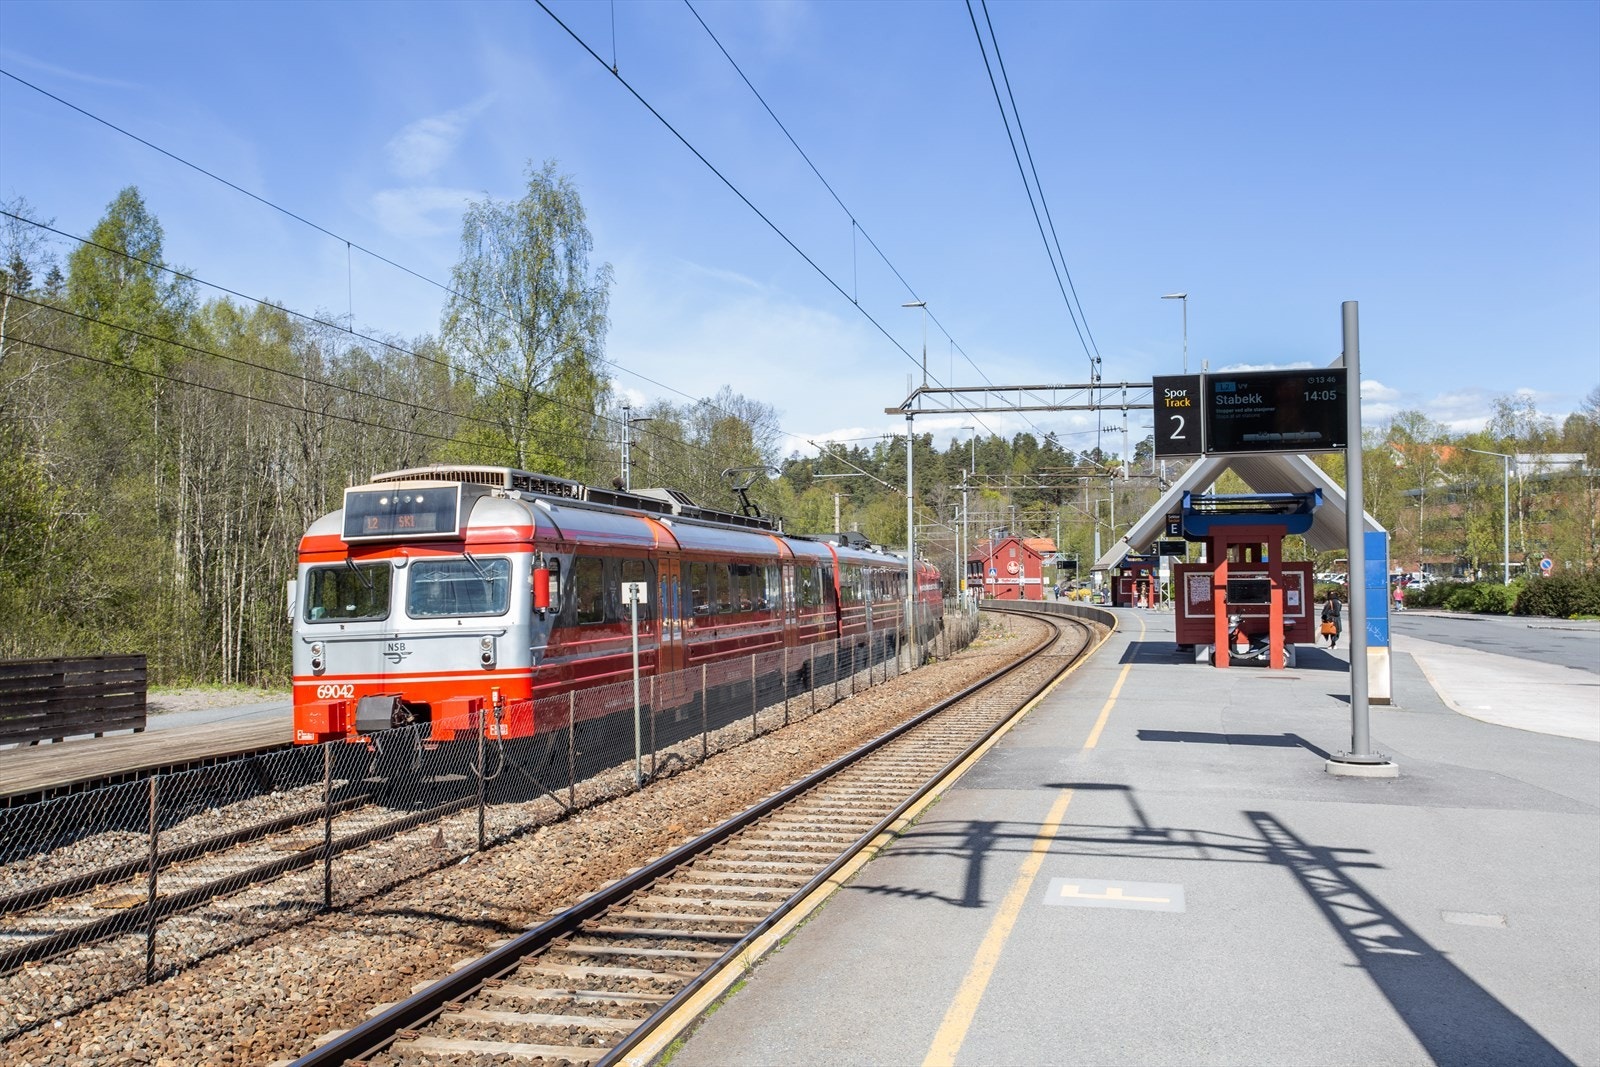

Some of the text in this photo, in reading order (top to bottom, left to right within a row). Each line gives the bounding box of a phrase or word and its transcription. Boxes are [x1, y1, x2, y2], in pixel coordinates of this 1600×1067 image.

[1164, 388, 1187, 399] Spor
[1215, 390, 1337, 405] Stabekk 14:05
[1164, 397, 1191, 408] Track
[1169, 414, 1186, 440] 2
[398, 515, 416, 528] SKI
[1171, 523, 1178, 534] E
[388, 643, 406, 652] NSB
[316, 684, 355, 699] 69042
